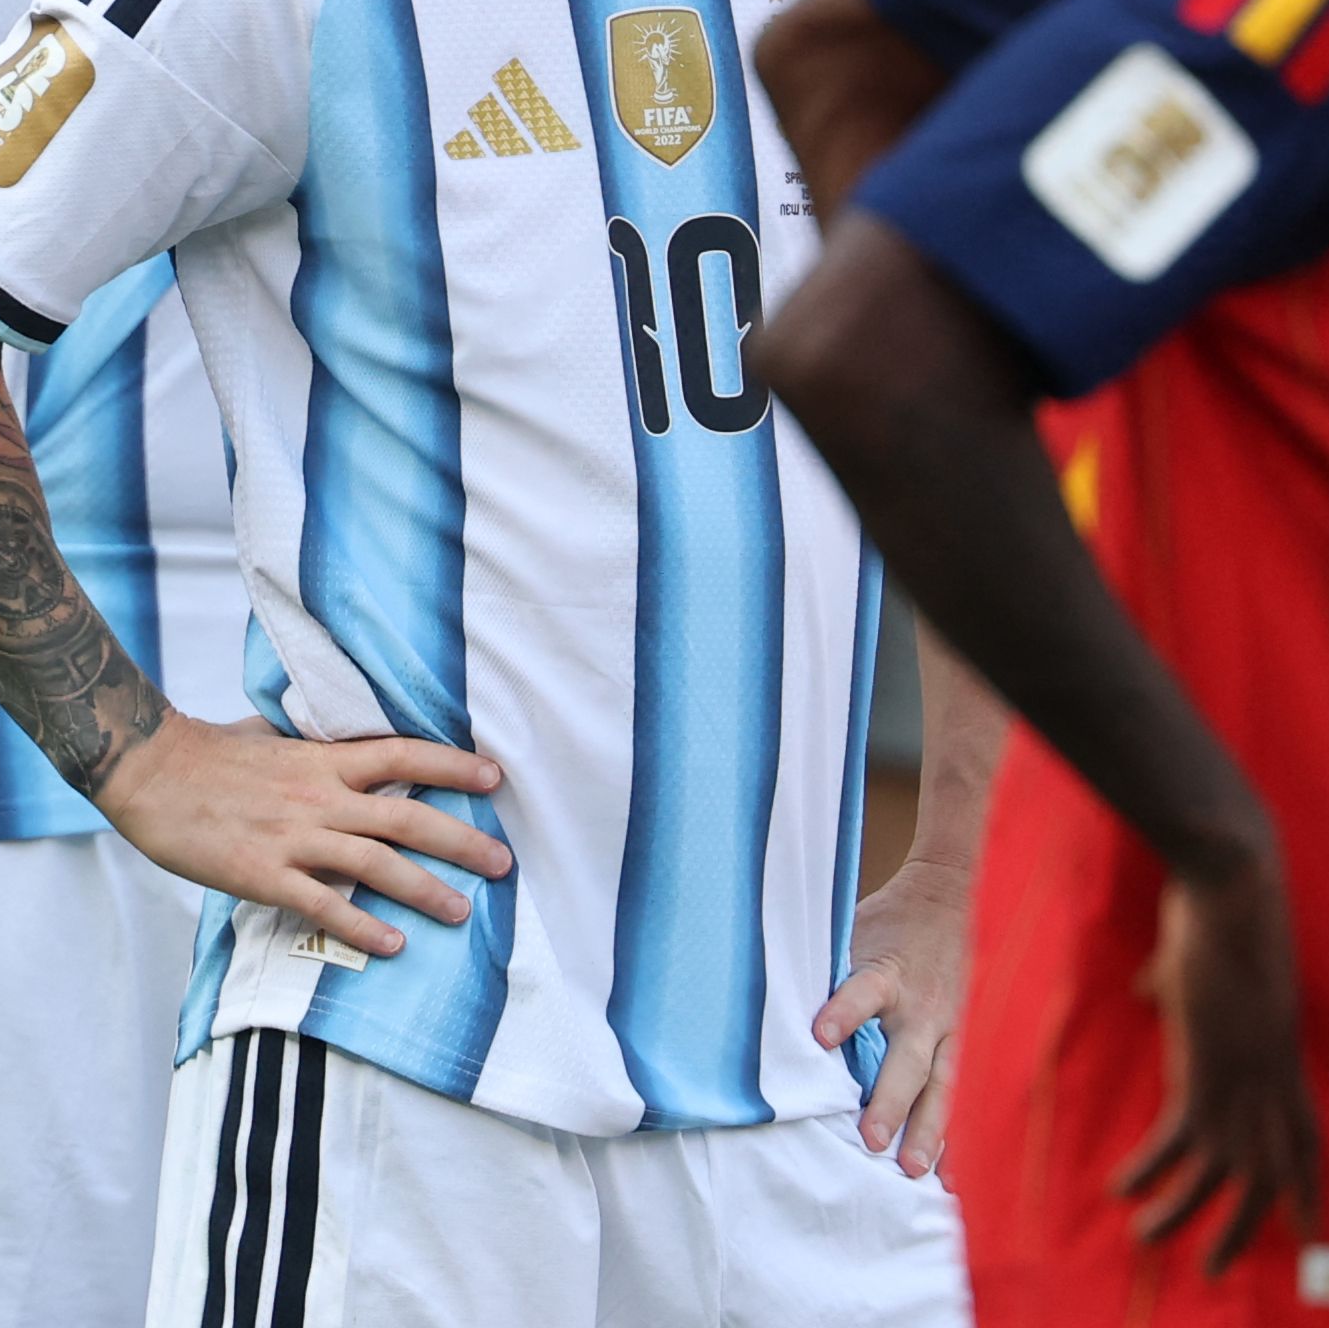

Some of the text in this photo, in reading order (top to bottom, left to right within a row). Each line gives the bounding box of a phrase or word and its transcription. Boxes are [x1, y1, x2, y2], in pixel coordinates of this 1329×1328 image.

[643, 106, 690, 127] FIFA
[634, 124, 702, 136] WORLD CHAMPIONS
[654, 134, 682, 147] 2022
[779, 203, 814, 216] NEW YO
[606, 213, 772, 437] 10
